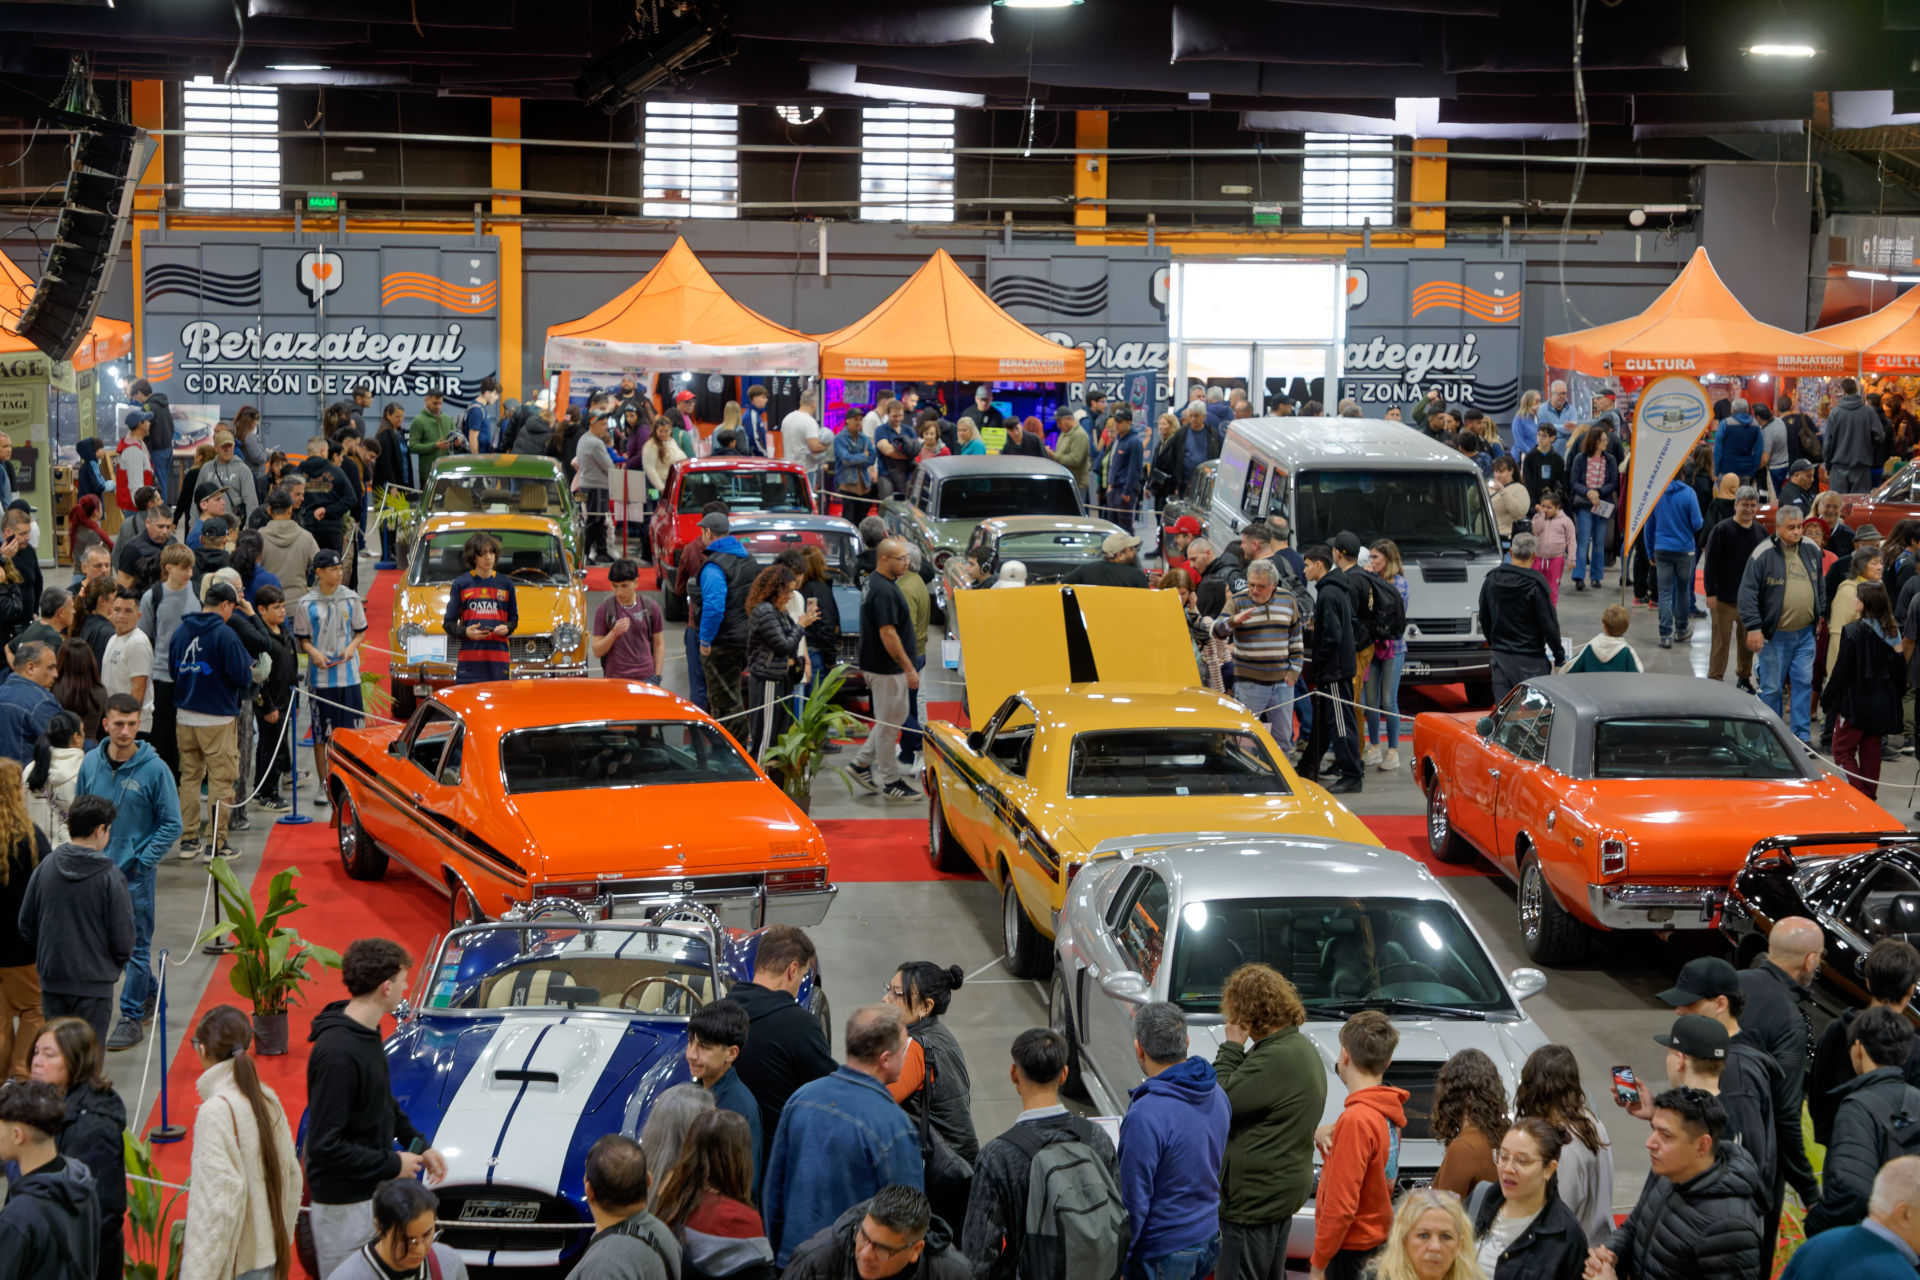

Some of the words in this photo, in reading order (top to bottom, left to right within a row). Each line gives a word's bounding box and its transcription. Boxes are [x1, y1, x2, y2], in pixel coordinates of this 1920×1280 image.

[309, 197, 336, 207] SALIDA
[180, 320, 465, 376] Berazategui
[844, 358, 888, 368] CULTURA
[1625, 358, 1696, 371] CULTURA
[1777, 355, 1844, 364] BERAZATEGUI
[185, 367, 301, 394] CORAZÓN
[307, 373, 338, 394] DE
[343, 373, 410, 396] ZONA
[414, 373, 463, 396] SUR
[1362, 384, 1424, 402] ZONA
[1631, 487, 1650, 533] AUTOCLUB
[1648, 437, 1672, 490] BERAZATEGUI
[469, 601, 498, 611] QATAR
[672, 881, 695, 891] SS
